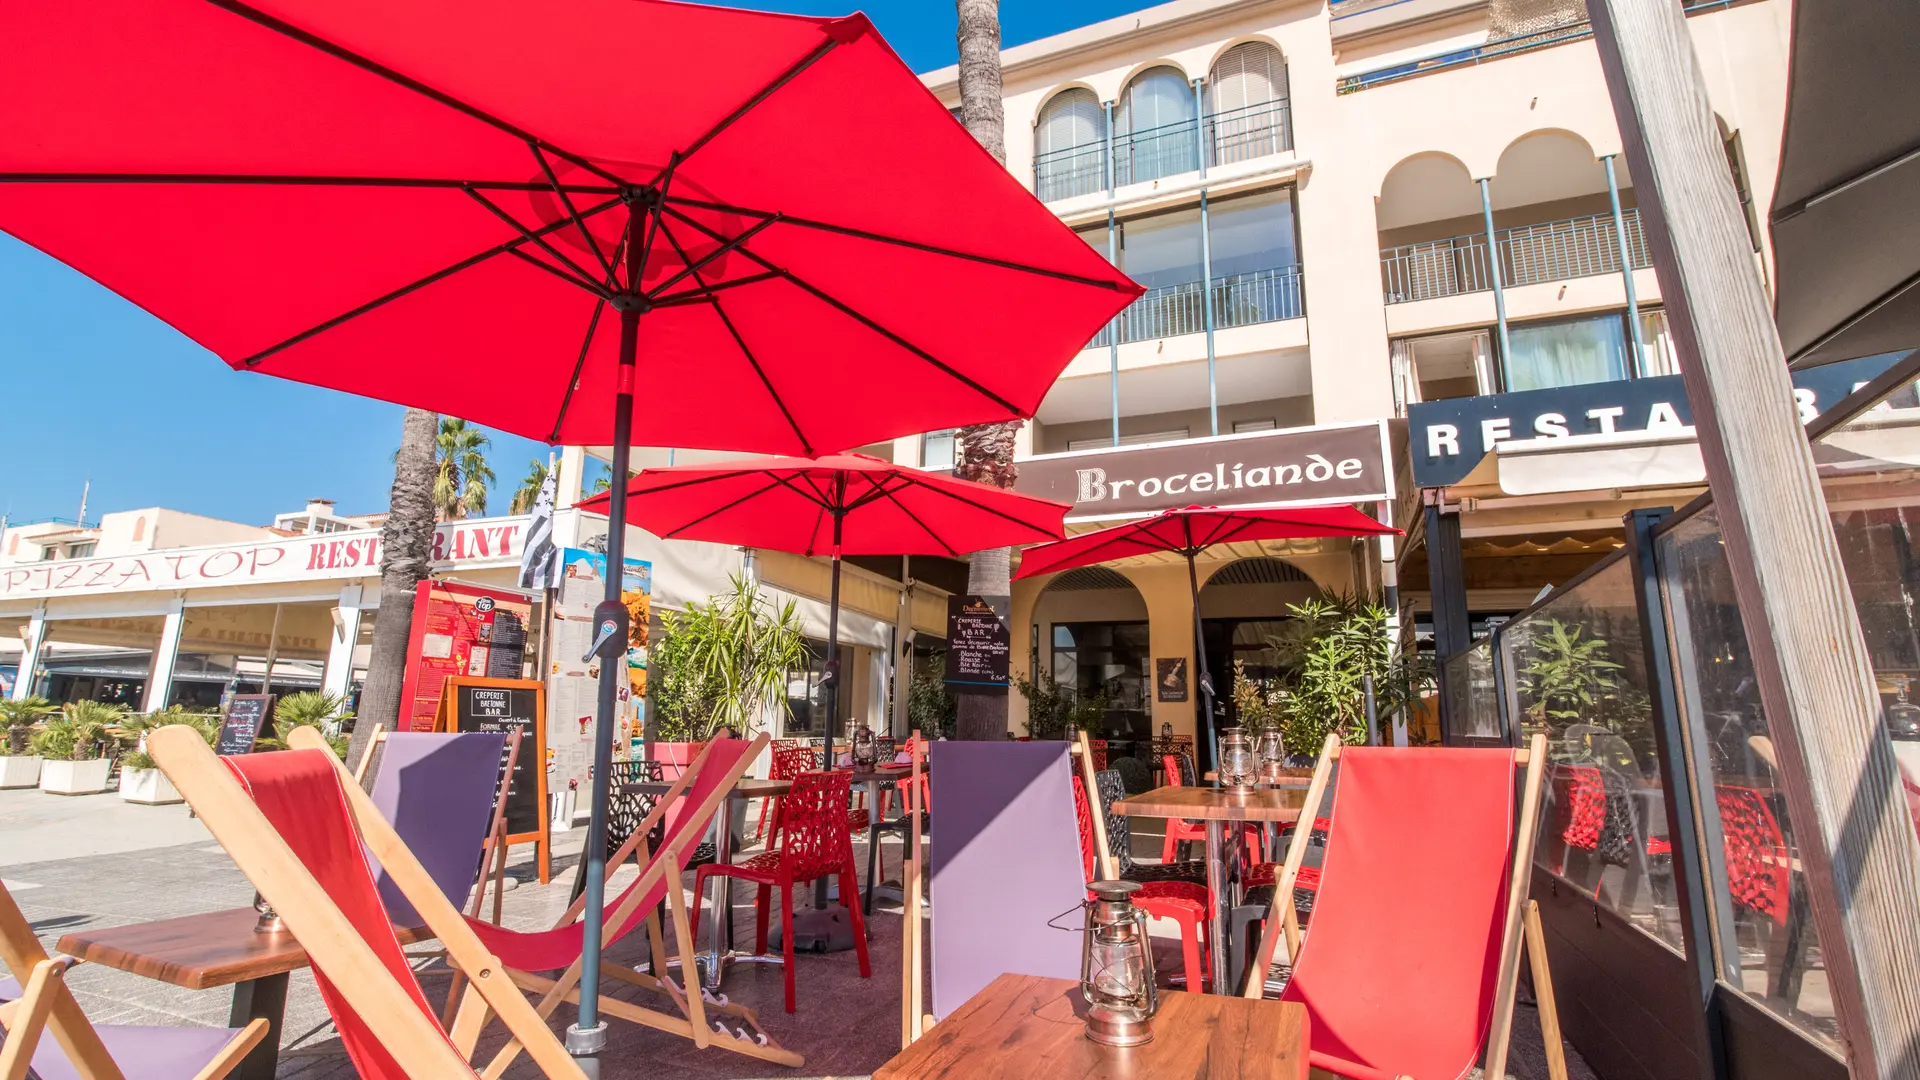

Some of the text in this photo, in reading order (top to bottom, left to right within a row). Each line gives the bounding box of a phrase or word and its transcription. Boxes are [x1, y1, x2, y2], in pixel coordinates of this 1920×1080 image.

[1076, 453, 1363, 503] Broceliande
[4, 525, 519, 592] PIZZA TOP RESTRANT
[475, 691, 504, 700] CREPERIE
[480, 700, 506, 708] BRETONNE
[485, 708, 500, 716] BAR
